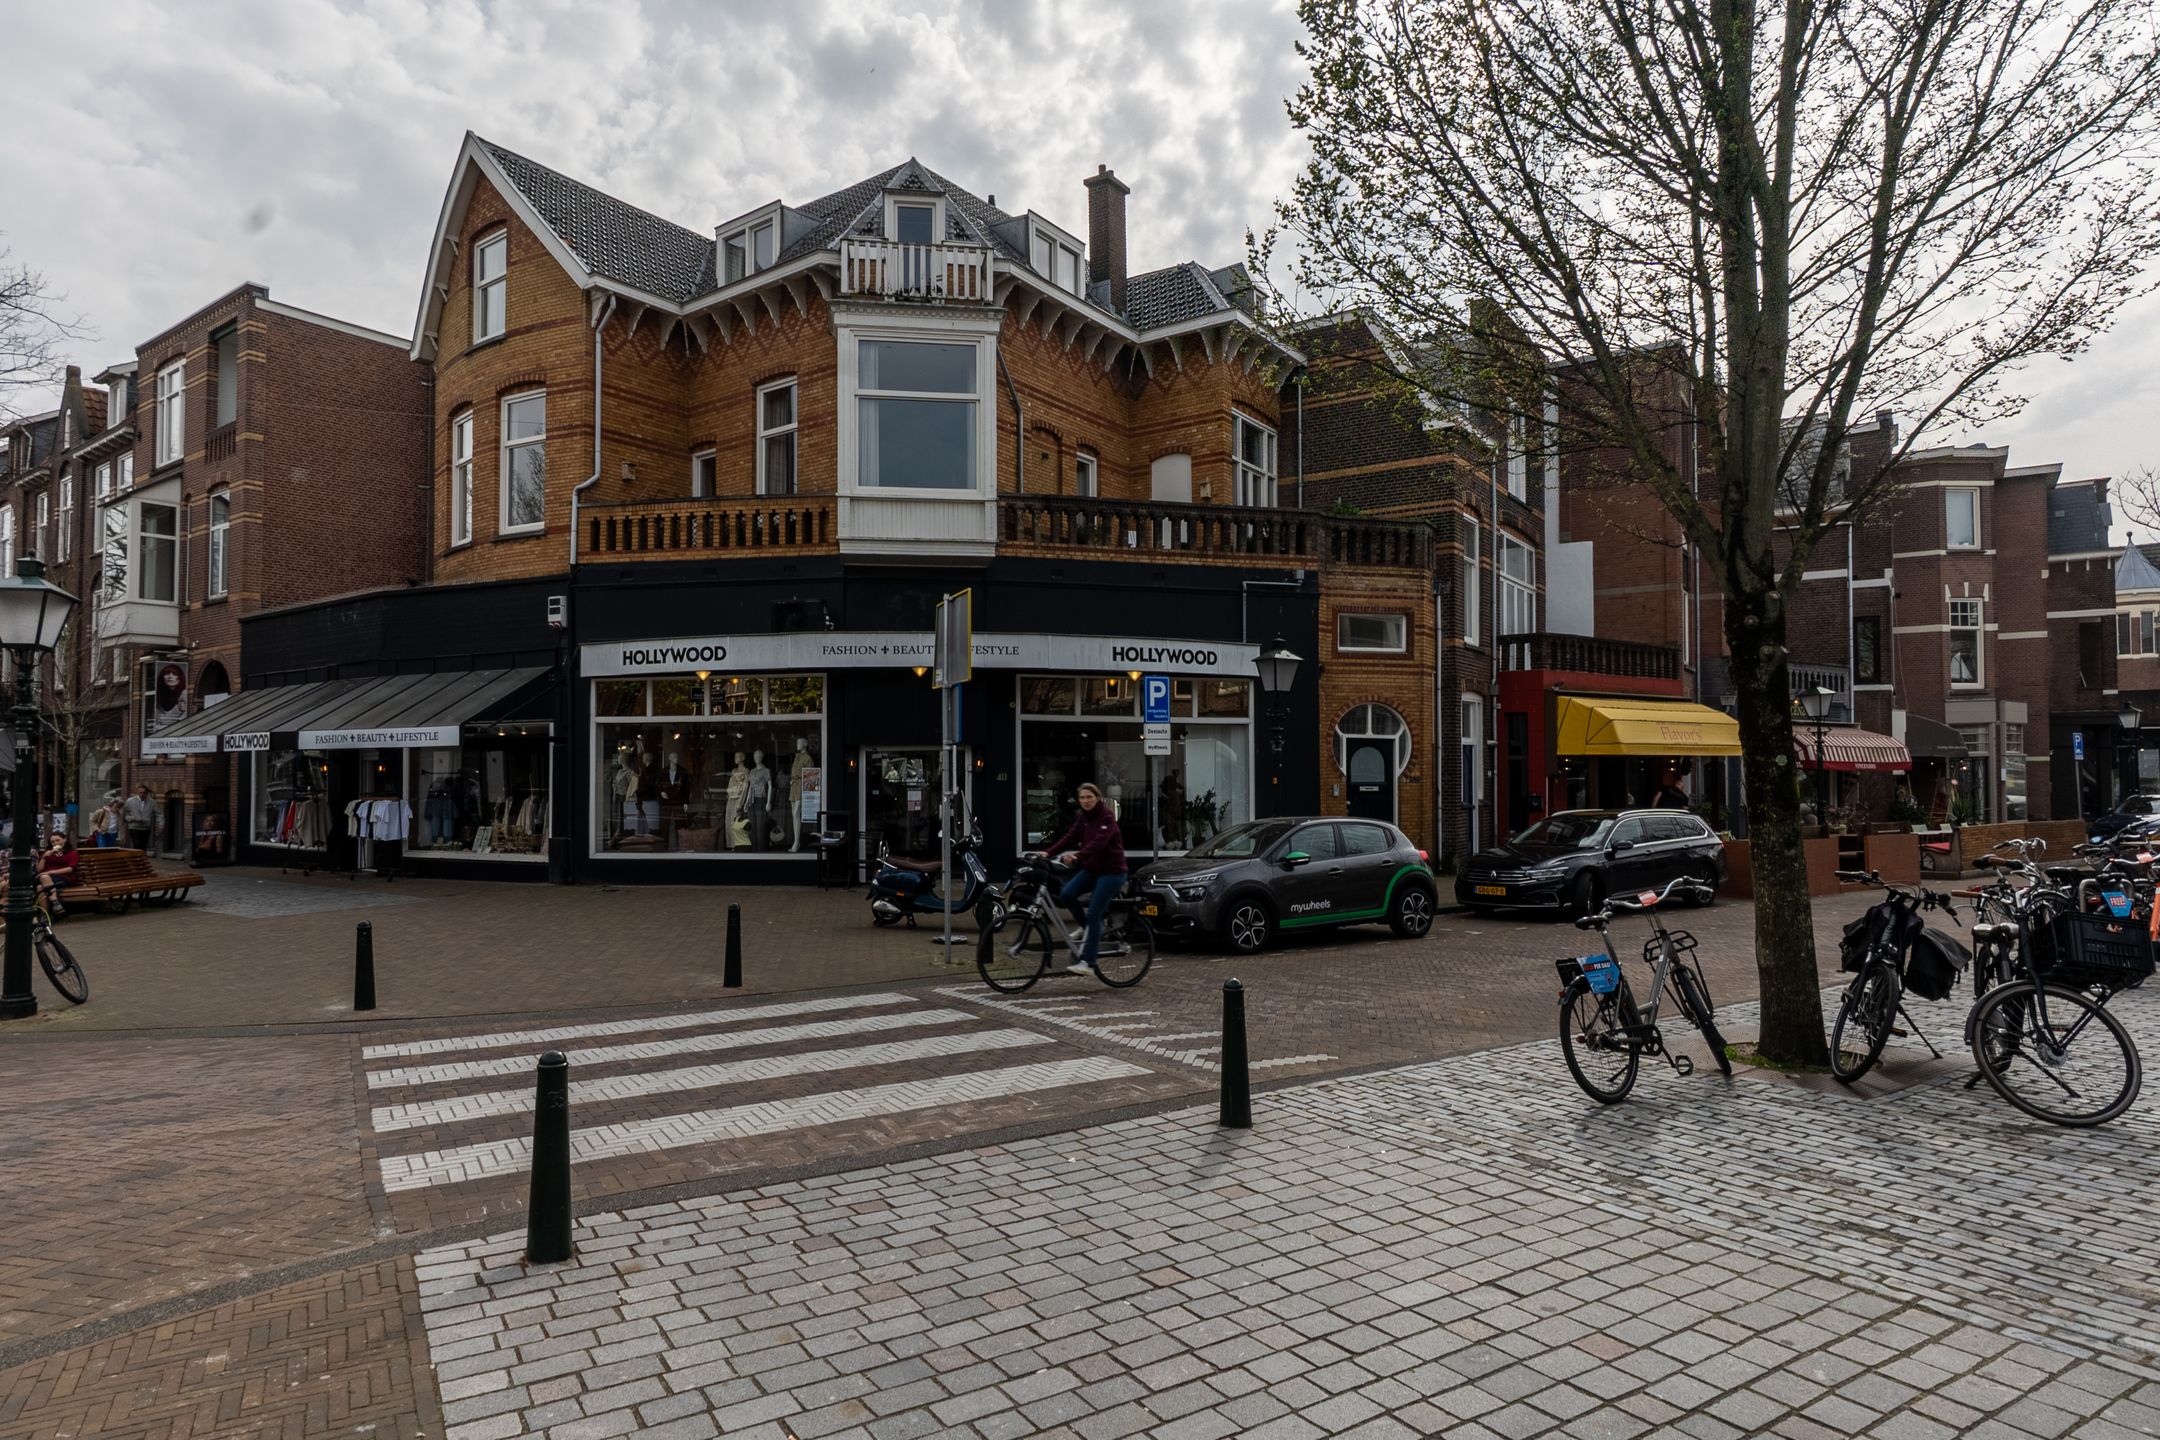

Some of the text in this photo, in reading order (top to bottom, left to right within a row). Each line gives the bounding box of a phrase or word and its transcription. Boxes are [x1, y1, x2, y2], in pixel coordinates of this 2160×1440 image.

[623, 646, 727, 665] HOLLYWOOD
[822, 645, 1020, 656] FASHION BEAUT ESTYLE
[1112, 646, 1217, 665] HOLLYWOOD
[1150, 680, 1167, 707] P
[225, 733, 269, 750] HOLLYWOOD
[315, 732, 439, 744] FASHION BEAUTY LIFESTYLE
[2074, 734, 2081, 746] P
[1290, 899, 1331, 913] mywheels
